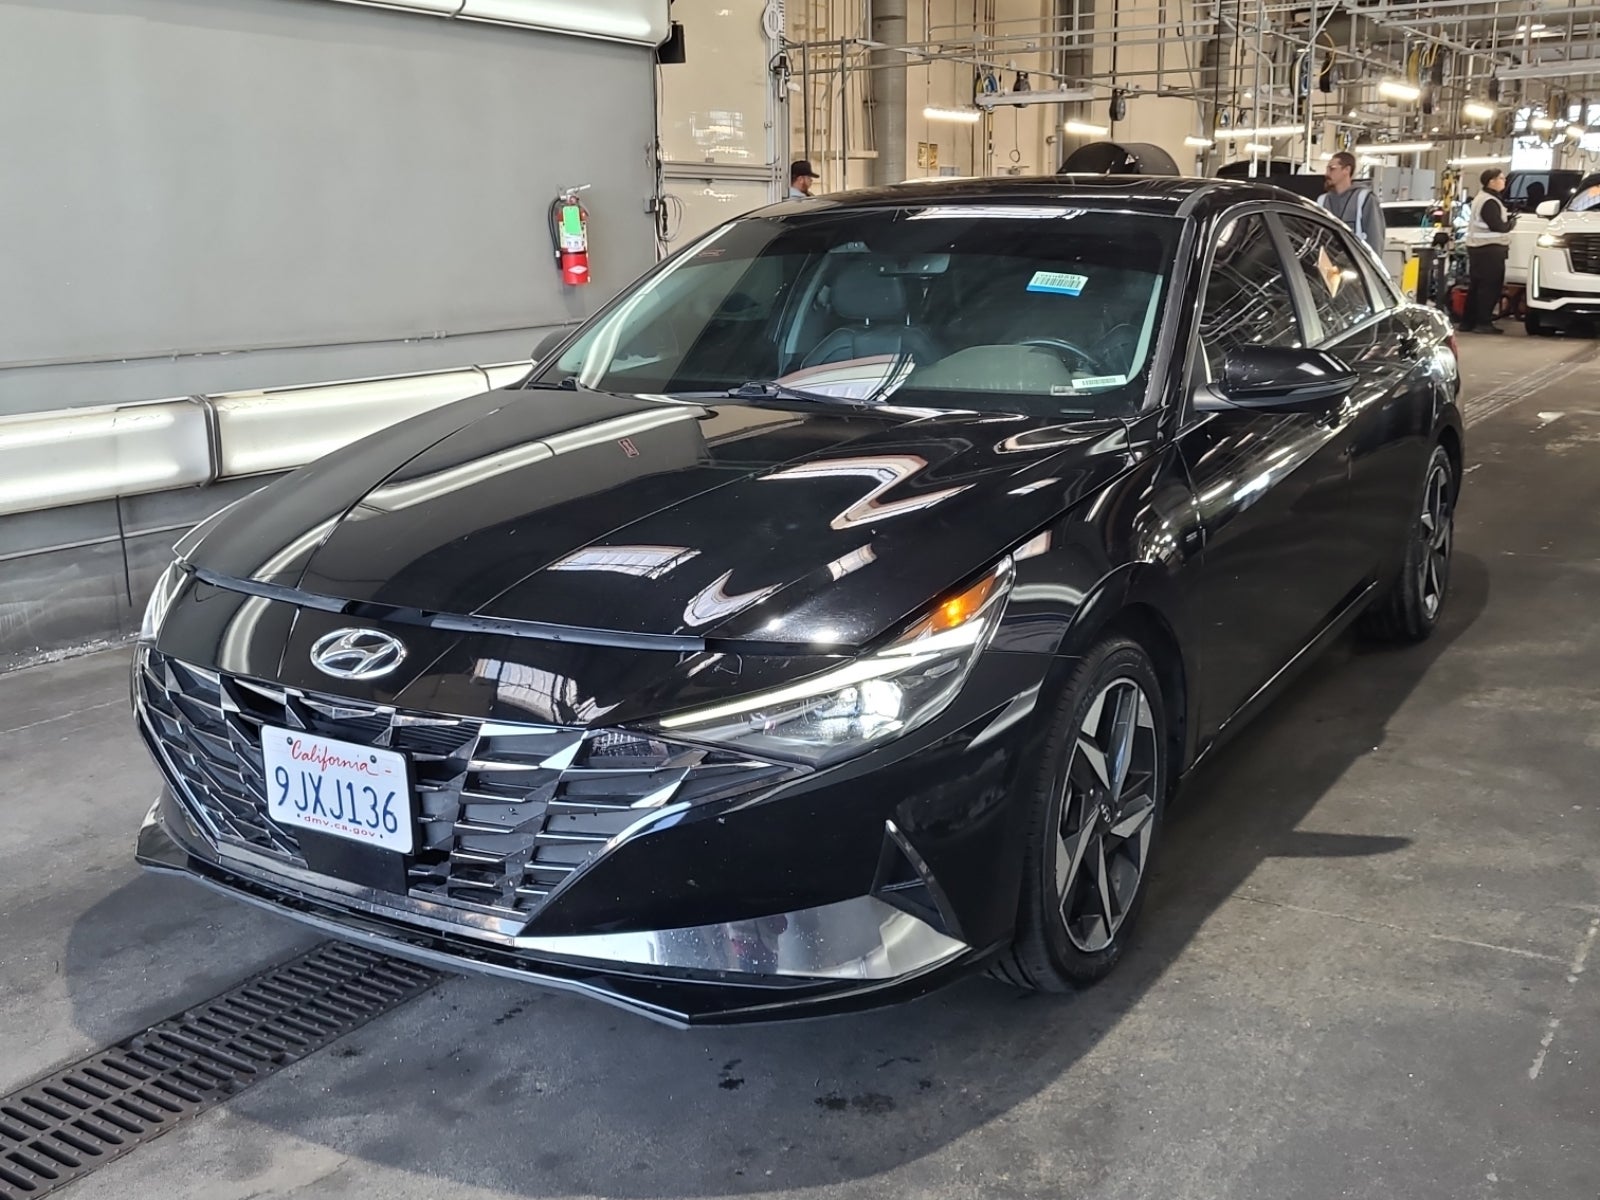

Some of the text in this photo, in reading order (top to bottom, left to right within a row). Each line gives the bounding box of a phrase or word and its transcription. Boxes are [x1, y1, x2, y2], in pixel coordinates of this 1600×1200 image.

[291, 740, 379, 776] California
[275, 765, 398, 834] 9JXJ136
[304, 815, 376, 838] dmv.ca.gov
